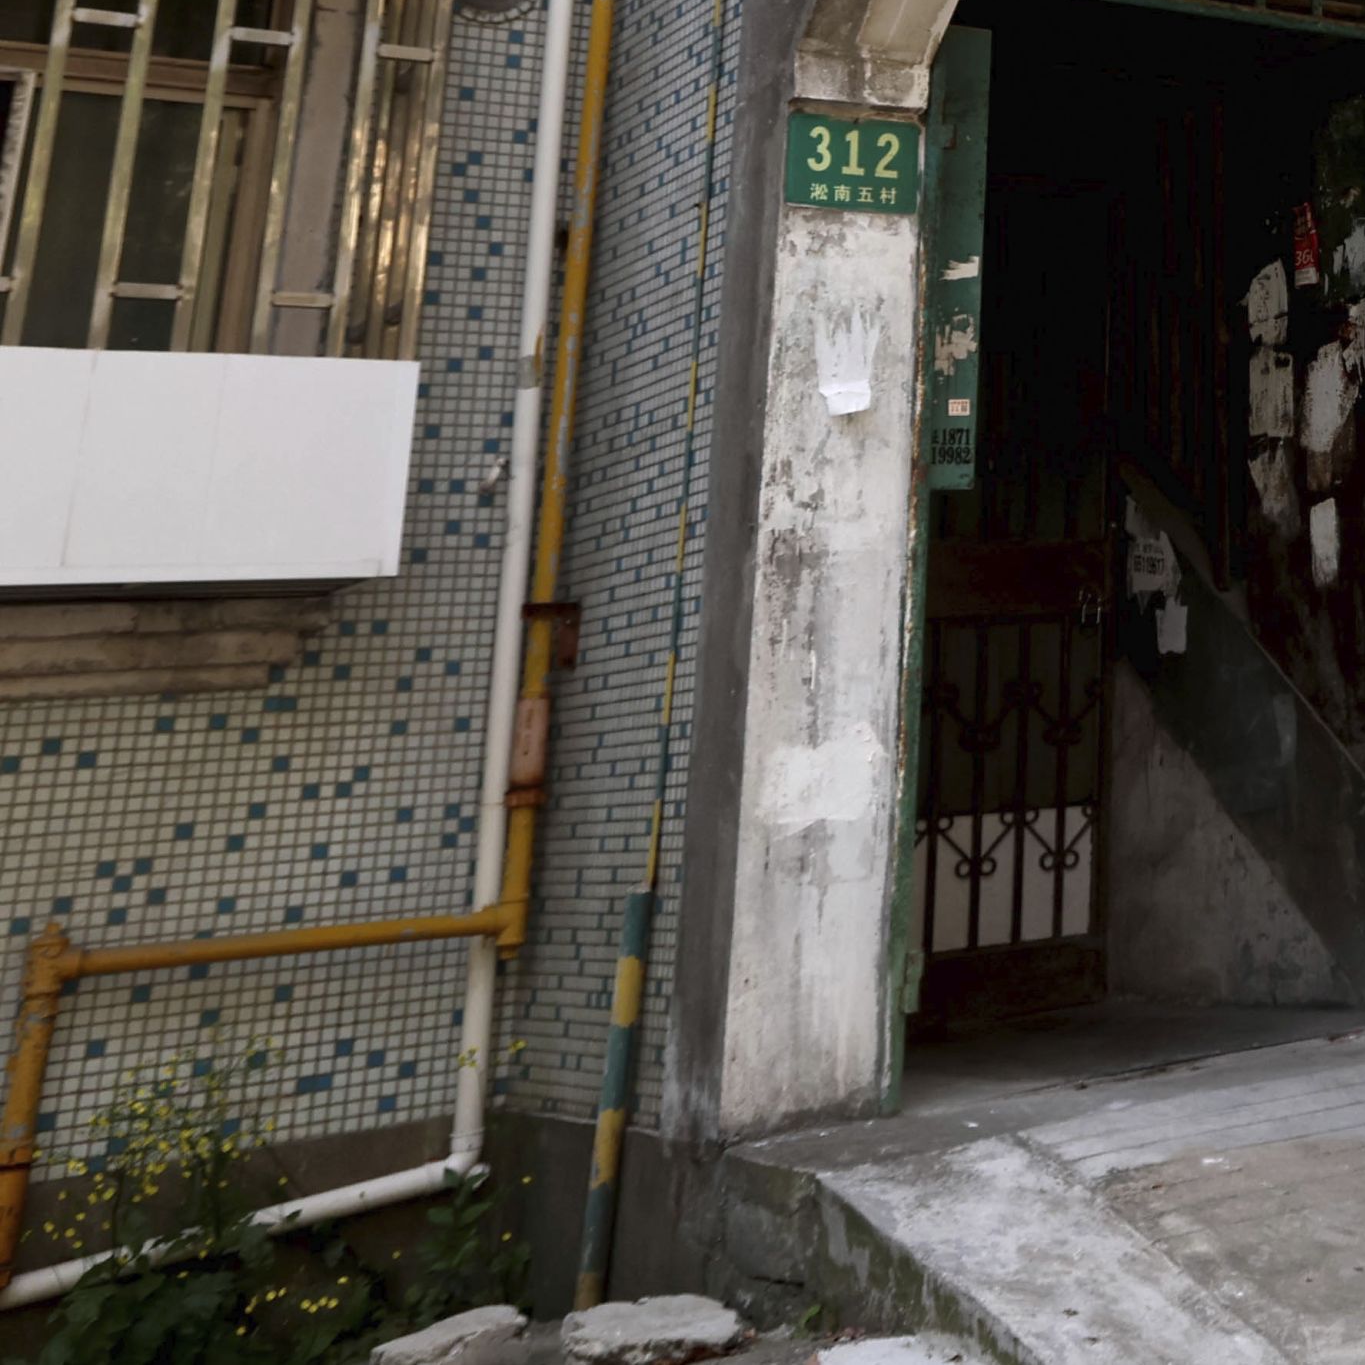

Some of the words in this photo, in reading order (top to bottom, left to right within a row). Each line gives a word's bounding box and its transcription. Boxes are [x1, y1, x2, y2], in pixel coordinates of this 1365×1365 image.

[806, 125, 900, 179] 312
[809, 182, 897, 205] 淞南五村
